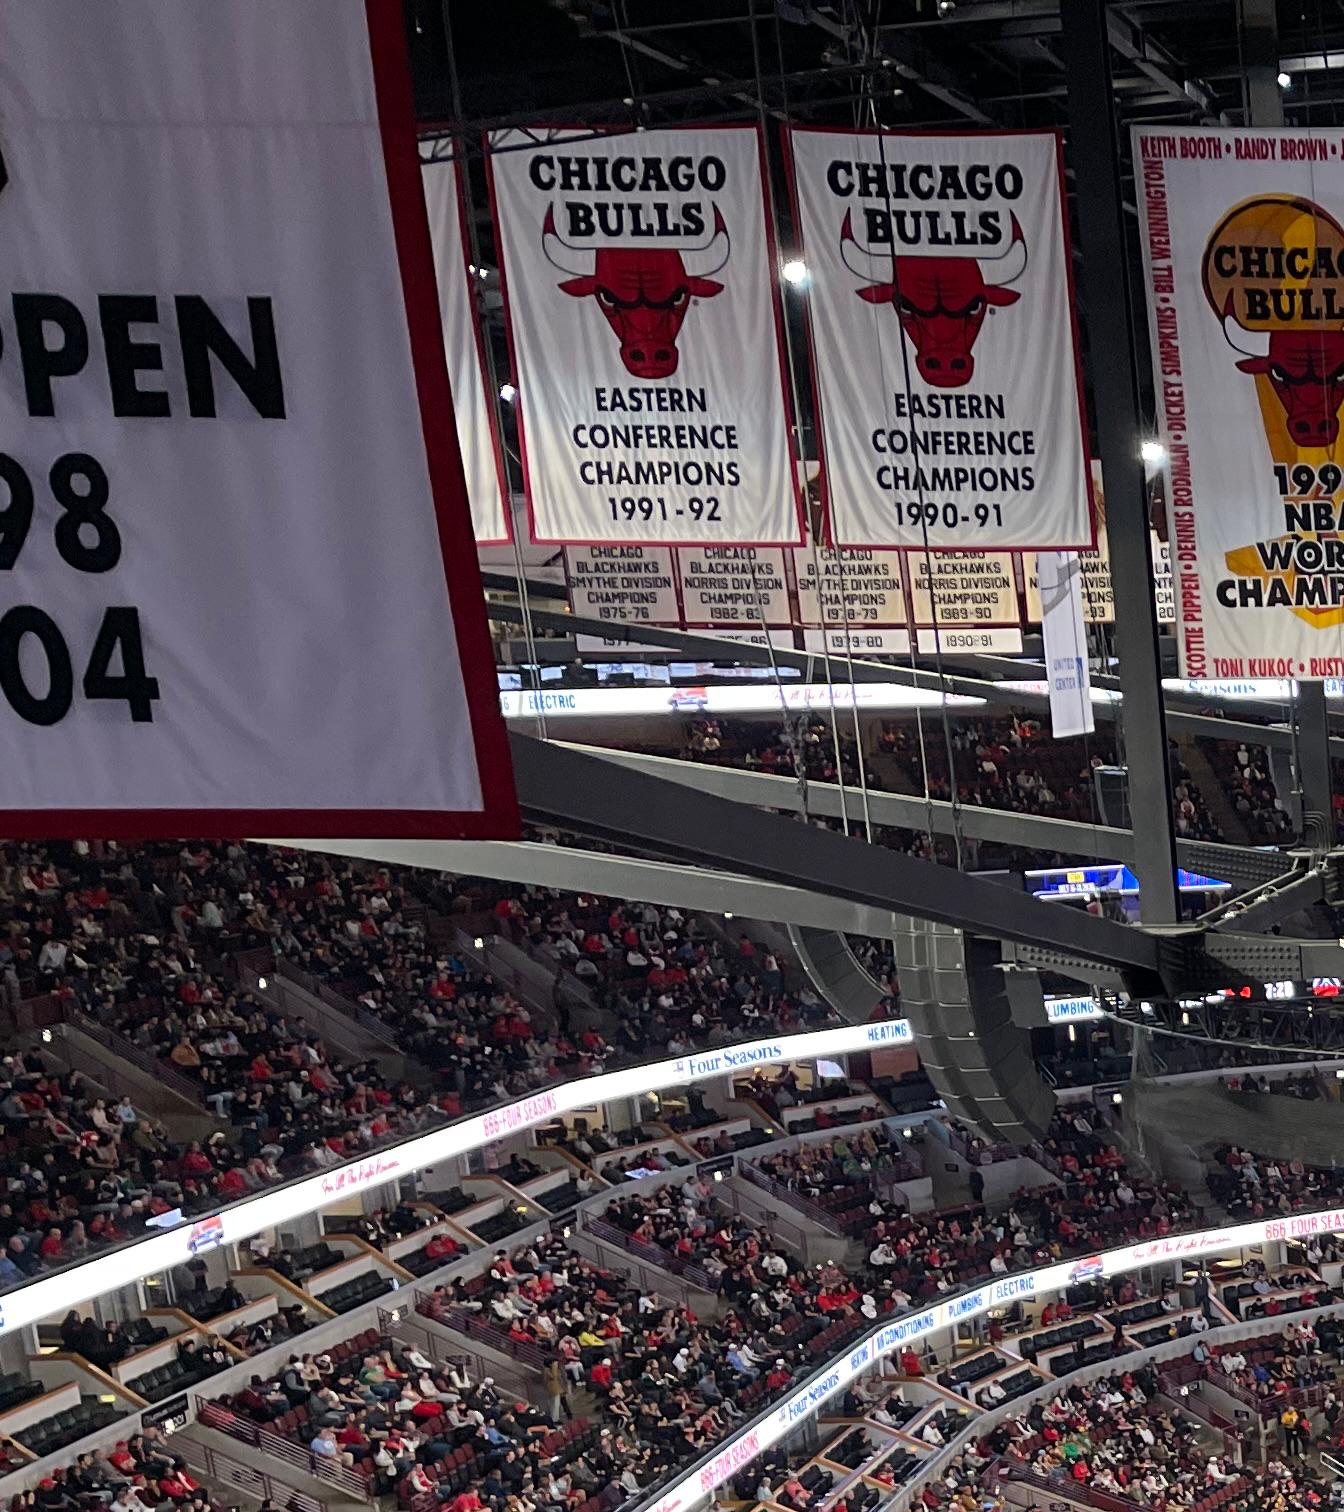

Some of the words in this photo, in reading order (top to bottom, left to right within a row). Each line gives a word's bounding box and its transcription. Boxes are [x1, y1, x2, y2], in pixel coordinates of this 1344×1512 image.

[1140, 137, 1176, 159] KEITH
[1179, 137, 1223, 159] BOOTH
[1235, 138, 1276, 160] RANDY
[1280, 138, 1328, 160] BROWN
[529, 155, 726, 192] CHICAGO
[827, 160, 1023, 200] CHICAGO
[565, 202, 705, 236] BULLS
[863, 207, 1002, 245] BULLS
[1143, 159, 1171, 260] WENNINGTON
[1152, 265, 1175, 294] BILL
[1155, 305, 1182, 375] SIMPKINS
[595, 387, 707, 412] EASTERN
[895, 393, 1005, 419] EASTERN
[1163, 378, 1187, 431] DICKEY
[573, 424, 738, 450] CONFERENCE
[872, 429, 1035, 455] CONFERENCE
[580, 461, 740, 486] CHAMPIONS
[877, 466, 1035, 491] CHAMPIONS
[1170, 445, 1193, 507] RODMAN
[1173, 512, 1197, 561] DENNIS
[1178, 572, 1202, 623] PIPPEN
[0, 605, 160, 726] 04
[1184, 625, 1206, 678] SCOTTIE
[1213, 658, 1245, 678] TONI
[1249, 658, 1294, 678] KUKOC
[690, 1057, 720, 1075] Four
[724, 1045, 782, 1068] Seasons
[867, 1023, 908, 1041] HEATING
